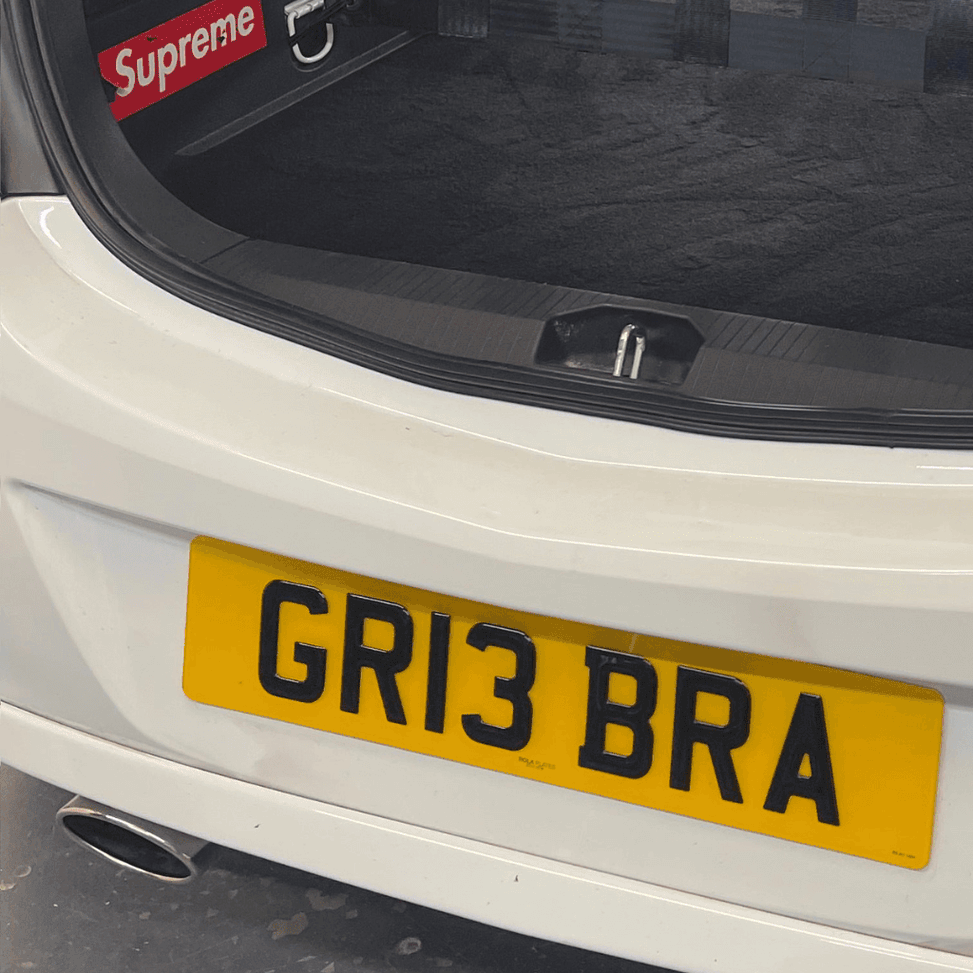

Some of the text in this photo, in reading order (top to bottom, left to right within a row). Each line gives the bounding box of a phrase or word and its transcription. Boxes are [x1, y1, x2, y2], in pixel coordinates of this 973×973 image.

[115, 5, 255, 98] Supreme
[258, 579, 841, 828] GR13 BRA
